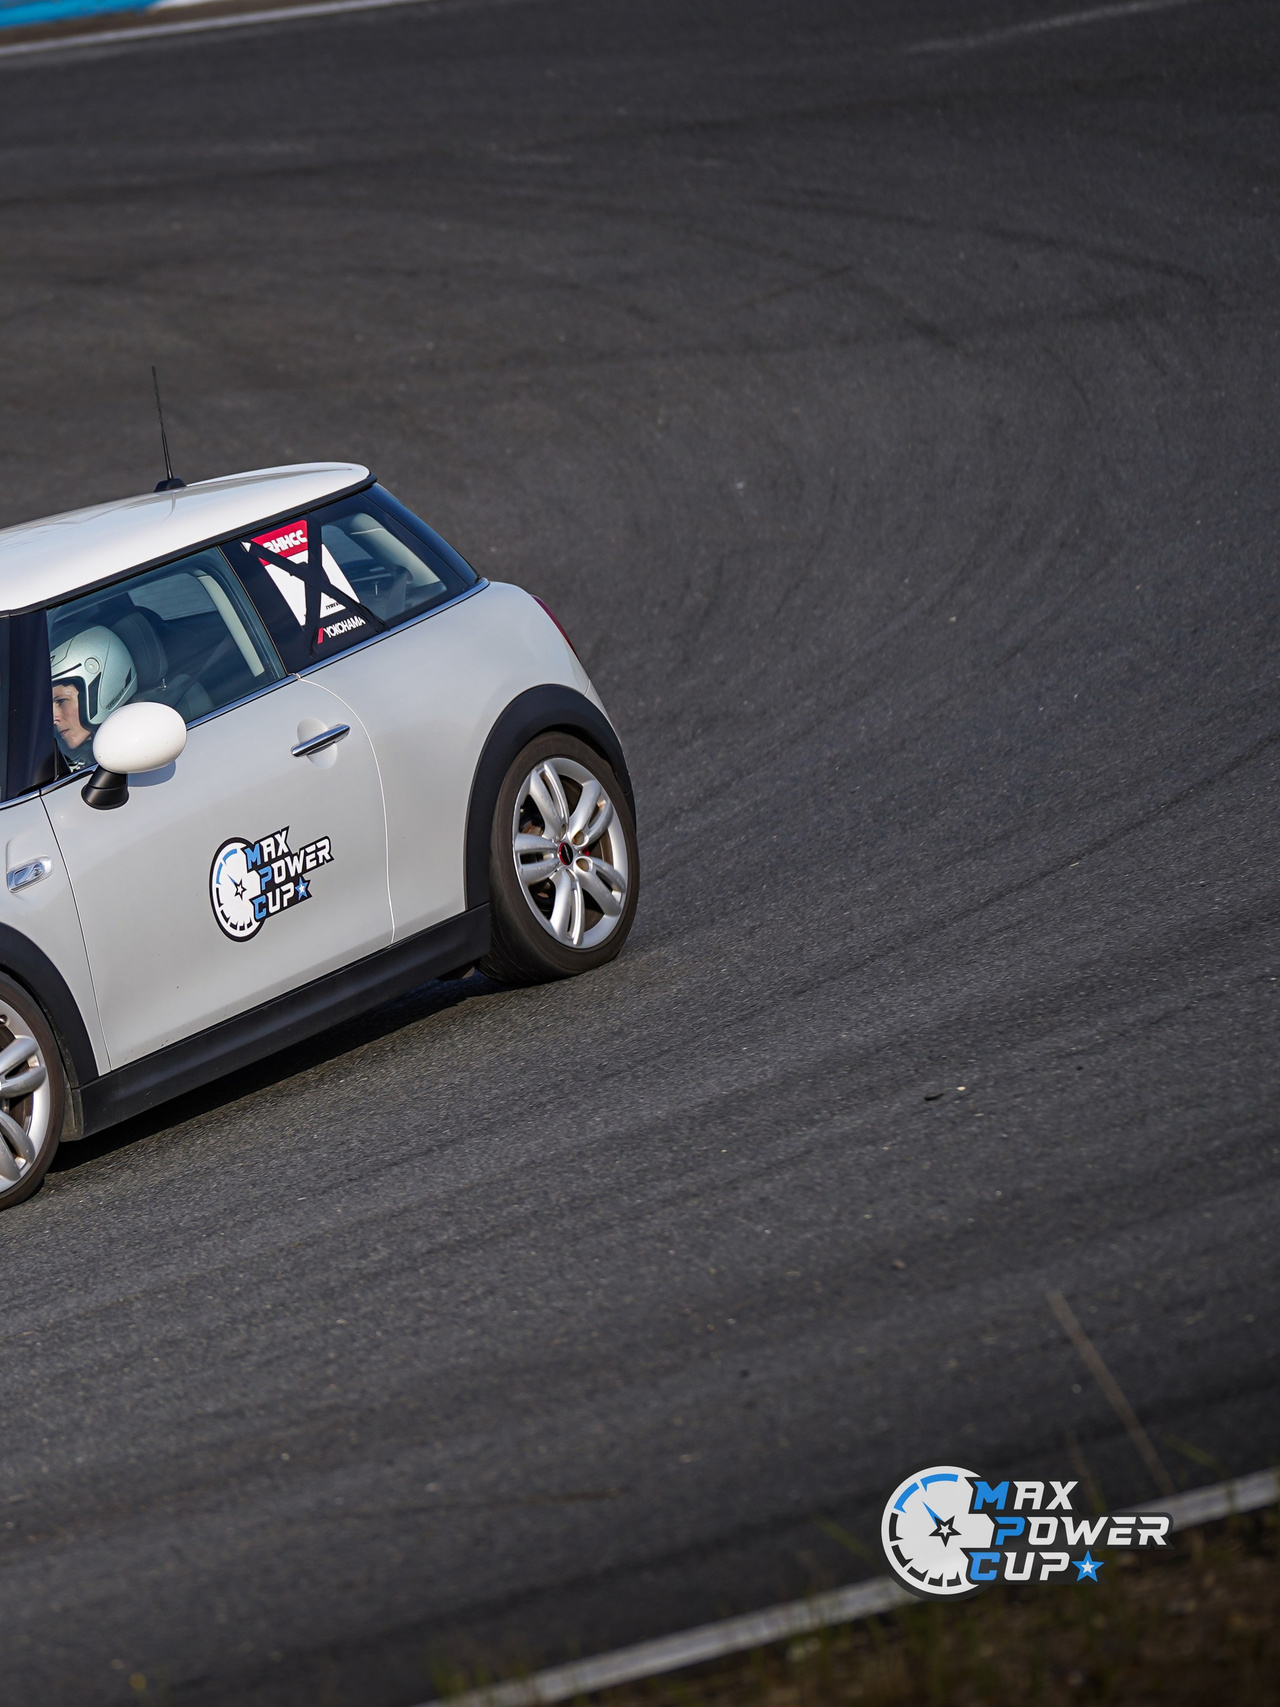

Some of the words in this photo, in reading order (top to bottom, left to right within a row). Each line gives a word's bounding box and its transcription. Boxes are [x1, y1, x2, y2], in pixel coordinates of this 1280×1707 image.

[323, 615, 366, 638] YOKOHAMA
[244, 829, 290, 869] MAX
[259, 838, 332, 890] POWER
[252, 882, 295, 920] CUP
